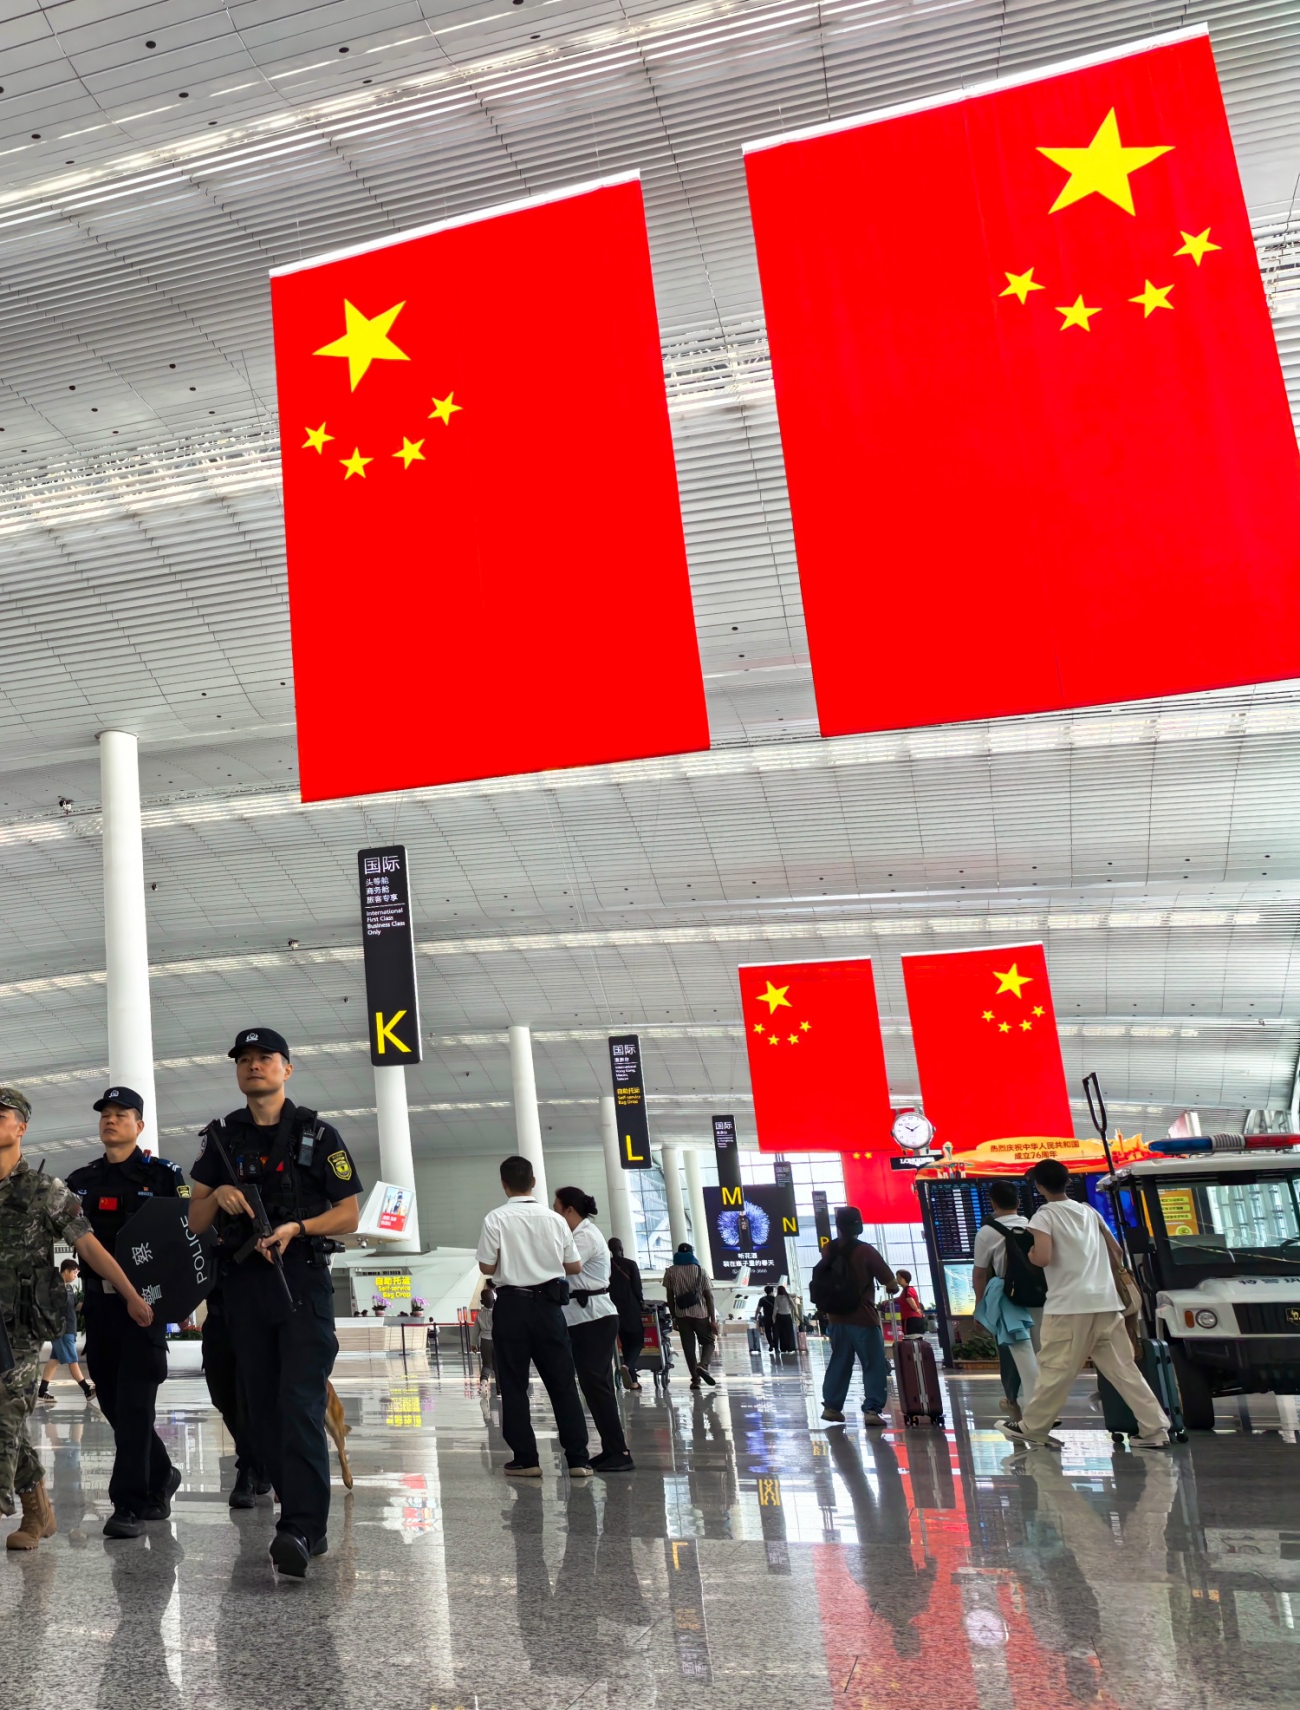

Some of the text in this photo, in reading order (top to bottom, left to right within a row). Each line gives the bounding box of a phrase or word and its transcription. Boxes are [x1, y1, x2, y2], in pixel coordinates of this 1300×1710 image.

[364, 855, 400, 874] 国际
[366, 908, 403, 916] International
[375, 1010, 412, 1054] K
[613, 1044, 637, 1056] 国际
[626, 1135, 643, 1161] L
[990, 1140, 1079, 1152] 热烈庆祝中华人民共和国
[1014, 1150, 1057, 1160] 成立76周年
[722, 1187, 742, 1205] M
[782, 1217, 797, 1232] N
[820, 1236, 830, 1248] P
